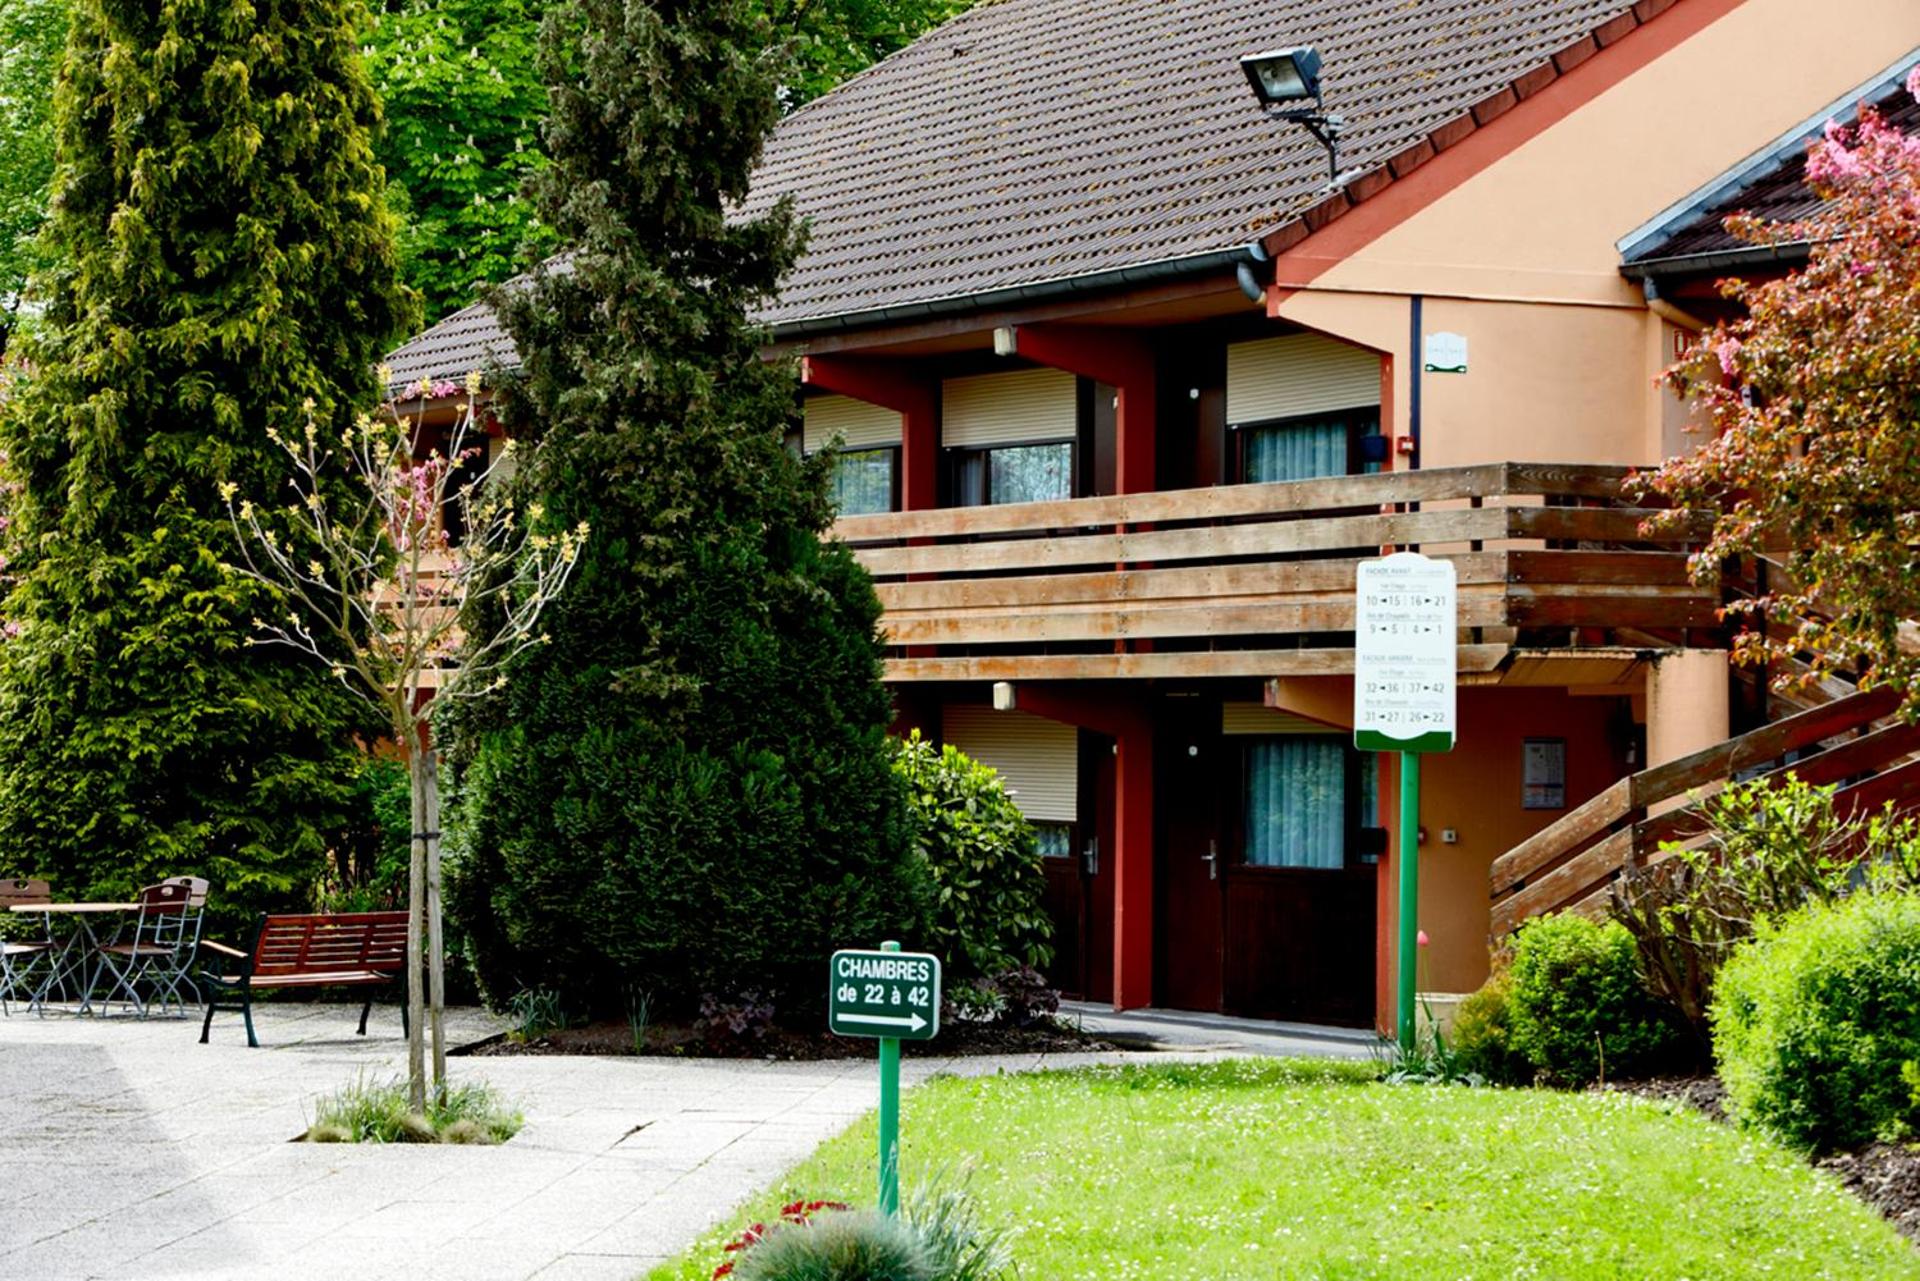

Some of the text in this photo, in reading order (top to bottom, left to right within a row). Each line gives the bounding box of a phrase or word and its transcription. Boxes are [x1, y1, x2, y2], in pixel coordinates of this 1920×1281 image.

[1366, 595, 1446, 606] 10 15 16 21
[1369, 623, 1376, 634] 9
[1391, 623, 1398, 634] 5
[1412, 624, 1419, 634] 4
[1365, 682, 1445, 694] 32 36 37 42
[1365, 711, 1445, 723] 31 27 26 22
[838, 957, 930, 982] CHAMBRES
[837, 982, 929, 1007] de 22 à 42
